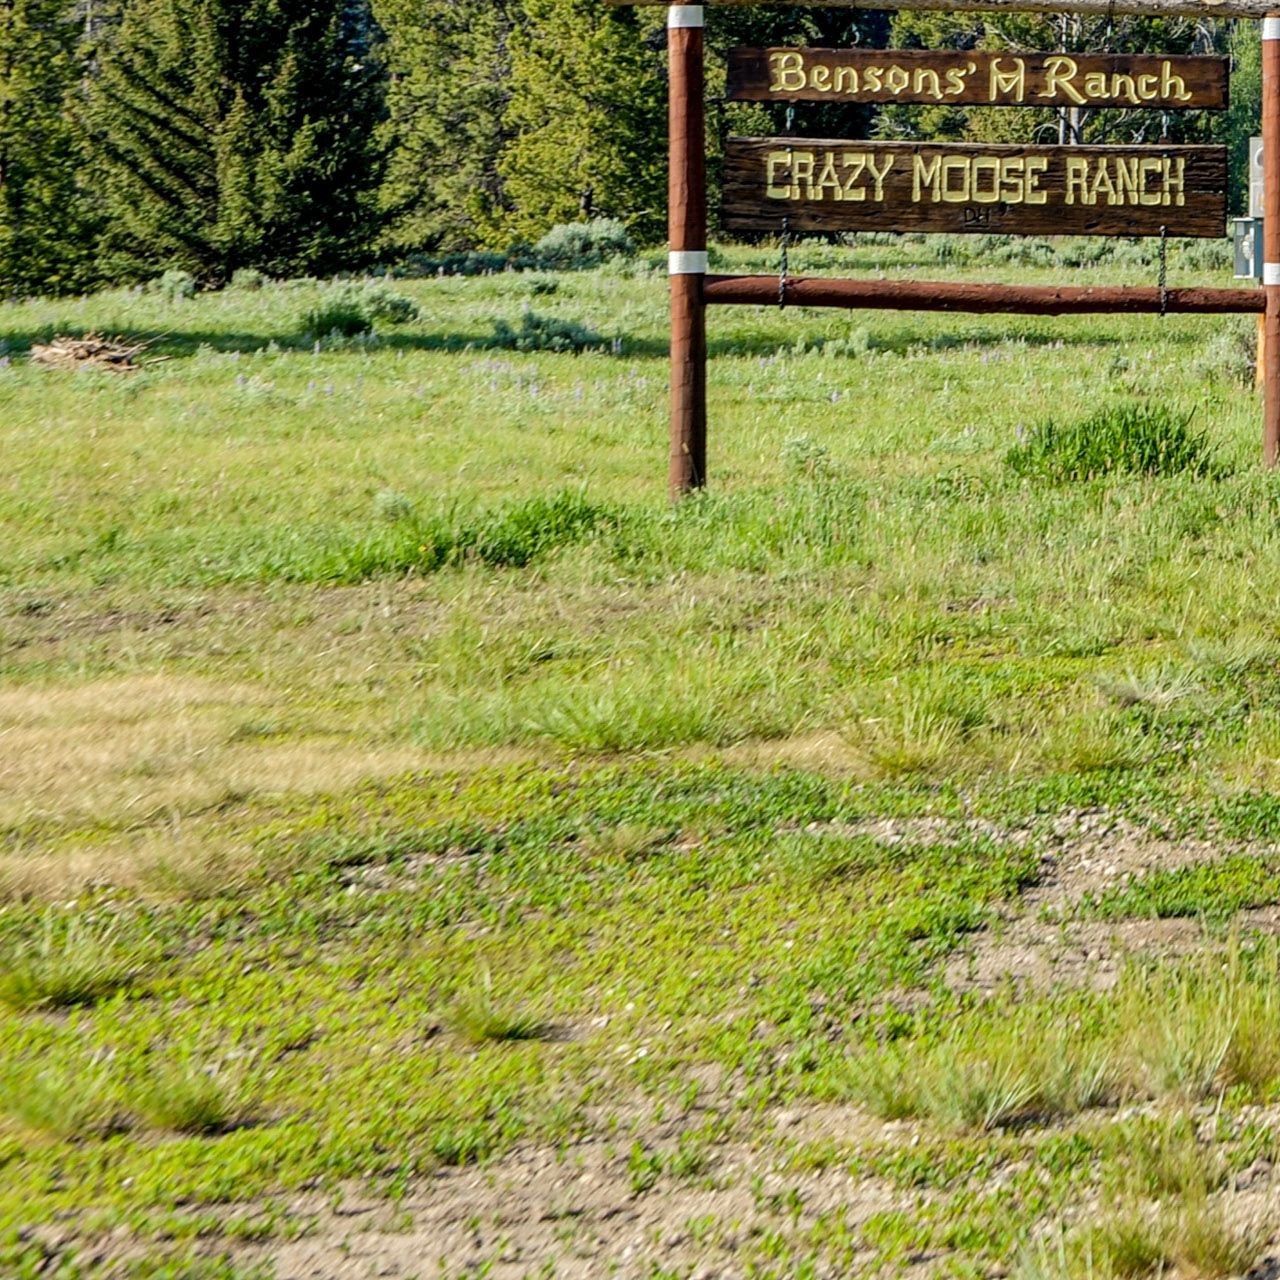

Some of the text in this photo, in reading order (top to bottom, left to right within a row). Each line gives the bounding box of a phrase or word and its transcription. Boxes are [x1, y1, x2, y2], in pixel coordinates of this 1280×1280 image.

[768, 51, 977, 100] Bensons'
[1037, 55, 1193, 105] Ranch
[766, 150, 1186, 207] CRAZY MOOSE RANCH
